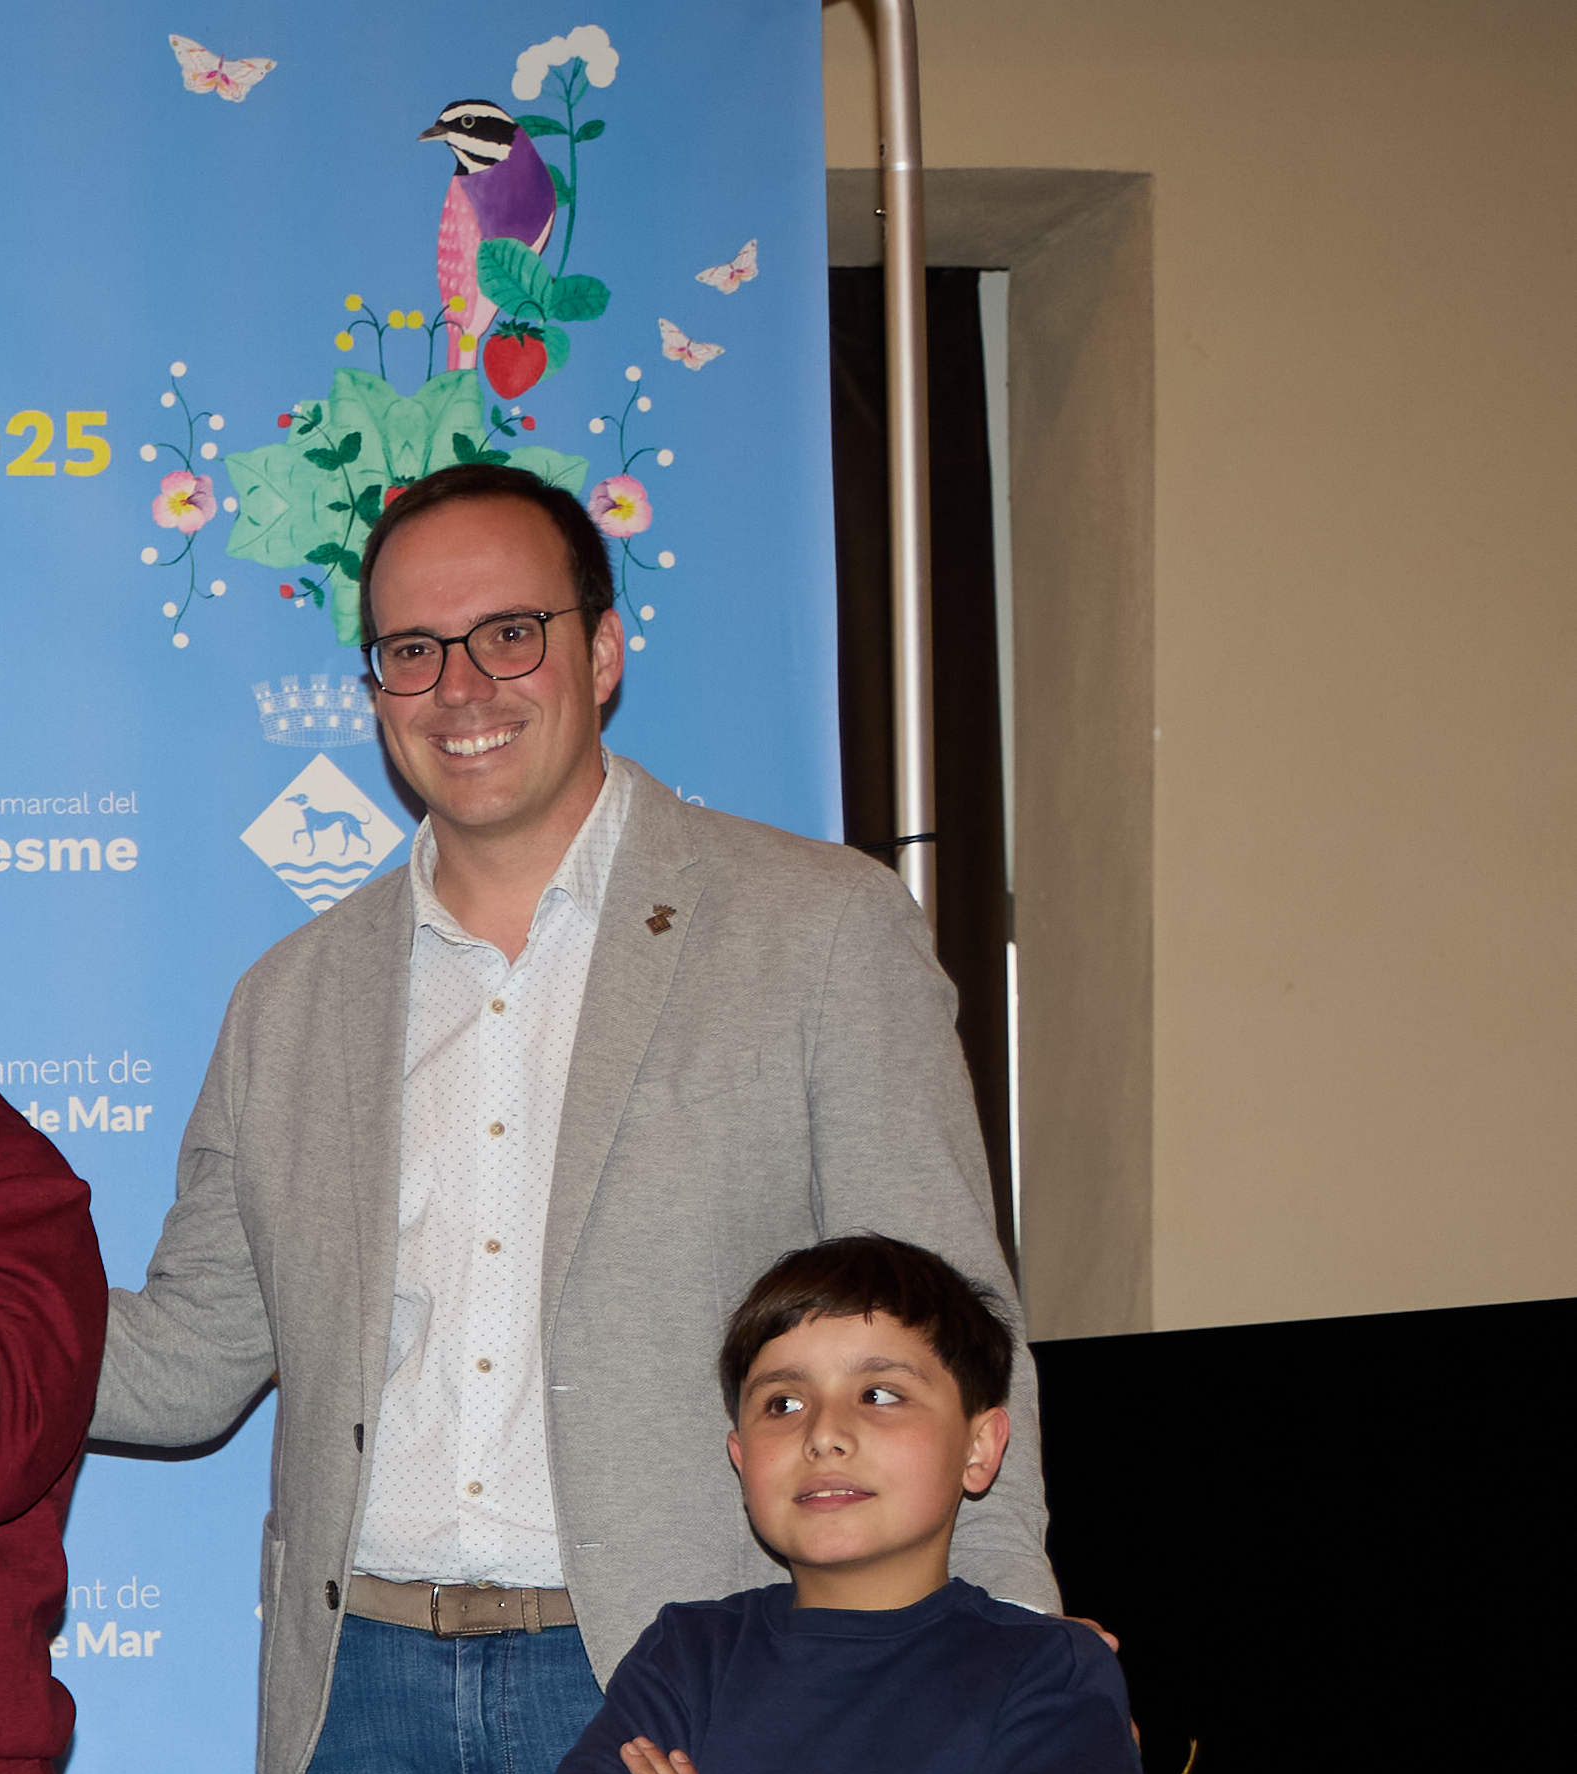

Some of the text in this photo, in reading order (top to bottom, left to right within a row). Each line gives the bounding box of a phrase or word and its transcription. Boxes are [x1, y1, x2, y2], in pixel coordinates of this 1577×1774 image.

[98, 791, 139, 814] del
[108, 1051, 152, 1083] de
[68, 1096, 152, 1132] Mar
[117, 1575, 160, 1609] de
[77, 1621, 162, 1658] Mar
